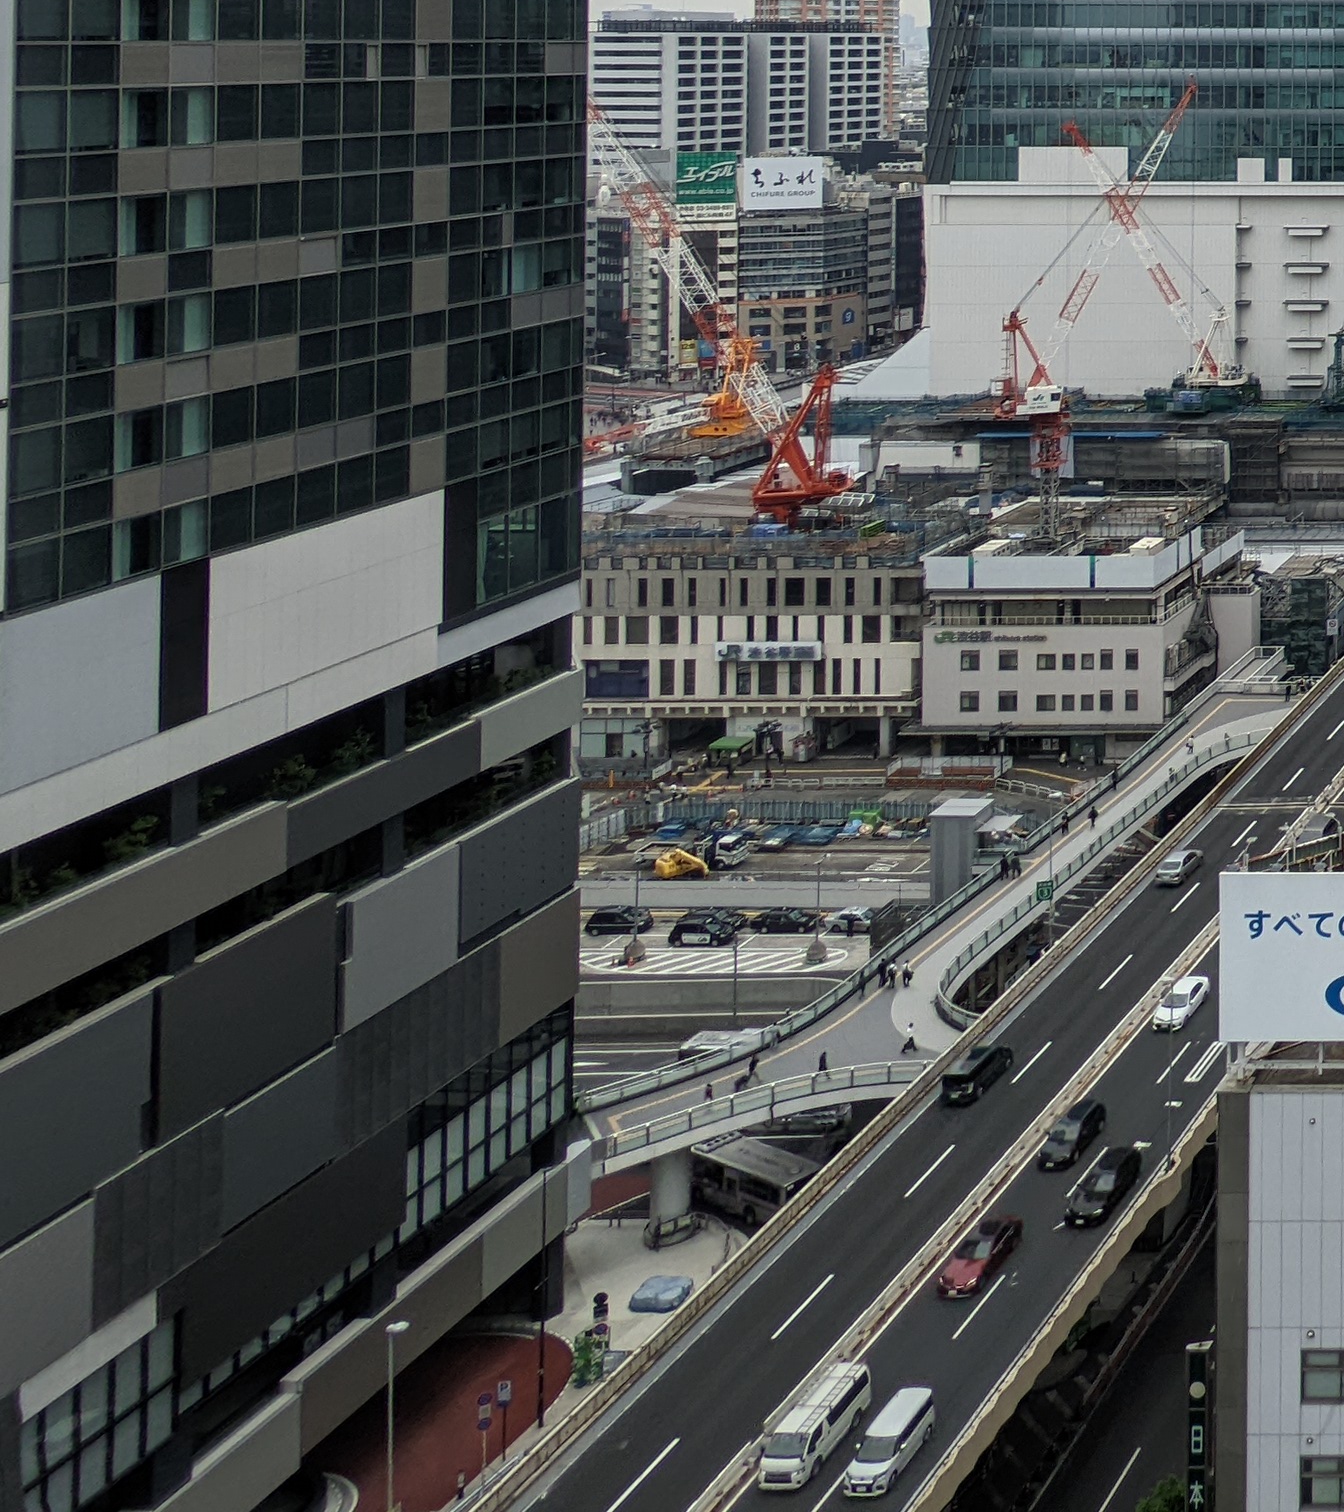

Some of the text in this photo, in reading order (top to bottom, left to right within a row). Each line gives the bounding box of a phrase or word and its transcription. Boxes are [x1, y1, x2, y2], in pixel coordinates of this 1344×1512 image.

[751, 168, 816, 188] ちふれ
[751, 190, 785, 198] CHIFURE
[718, 645, 743, 661] JR
